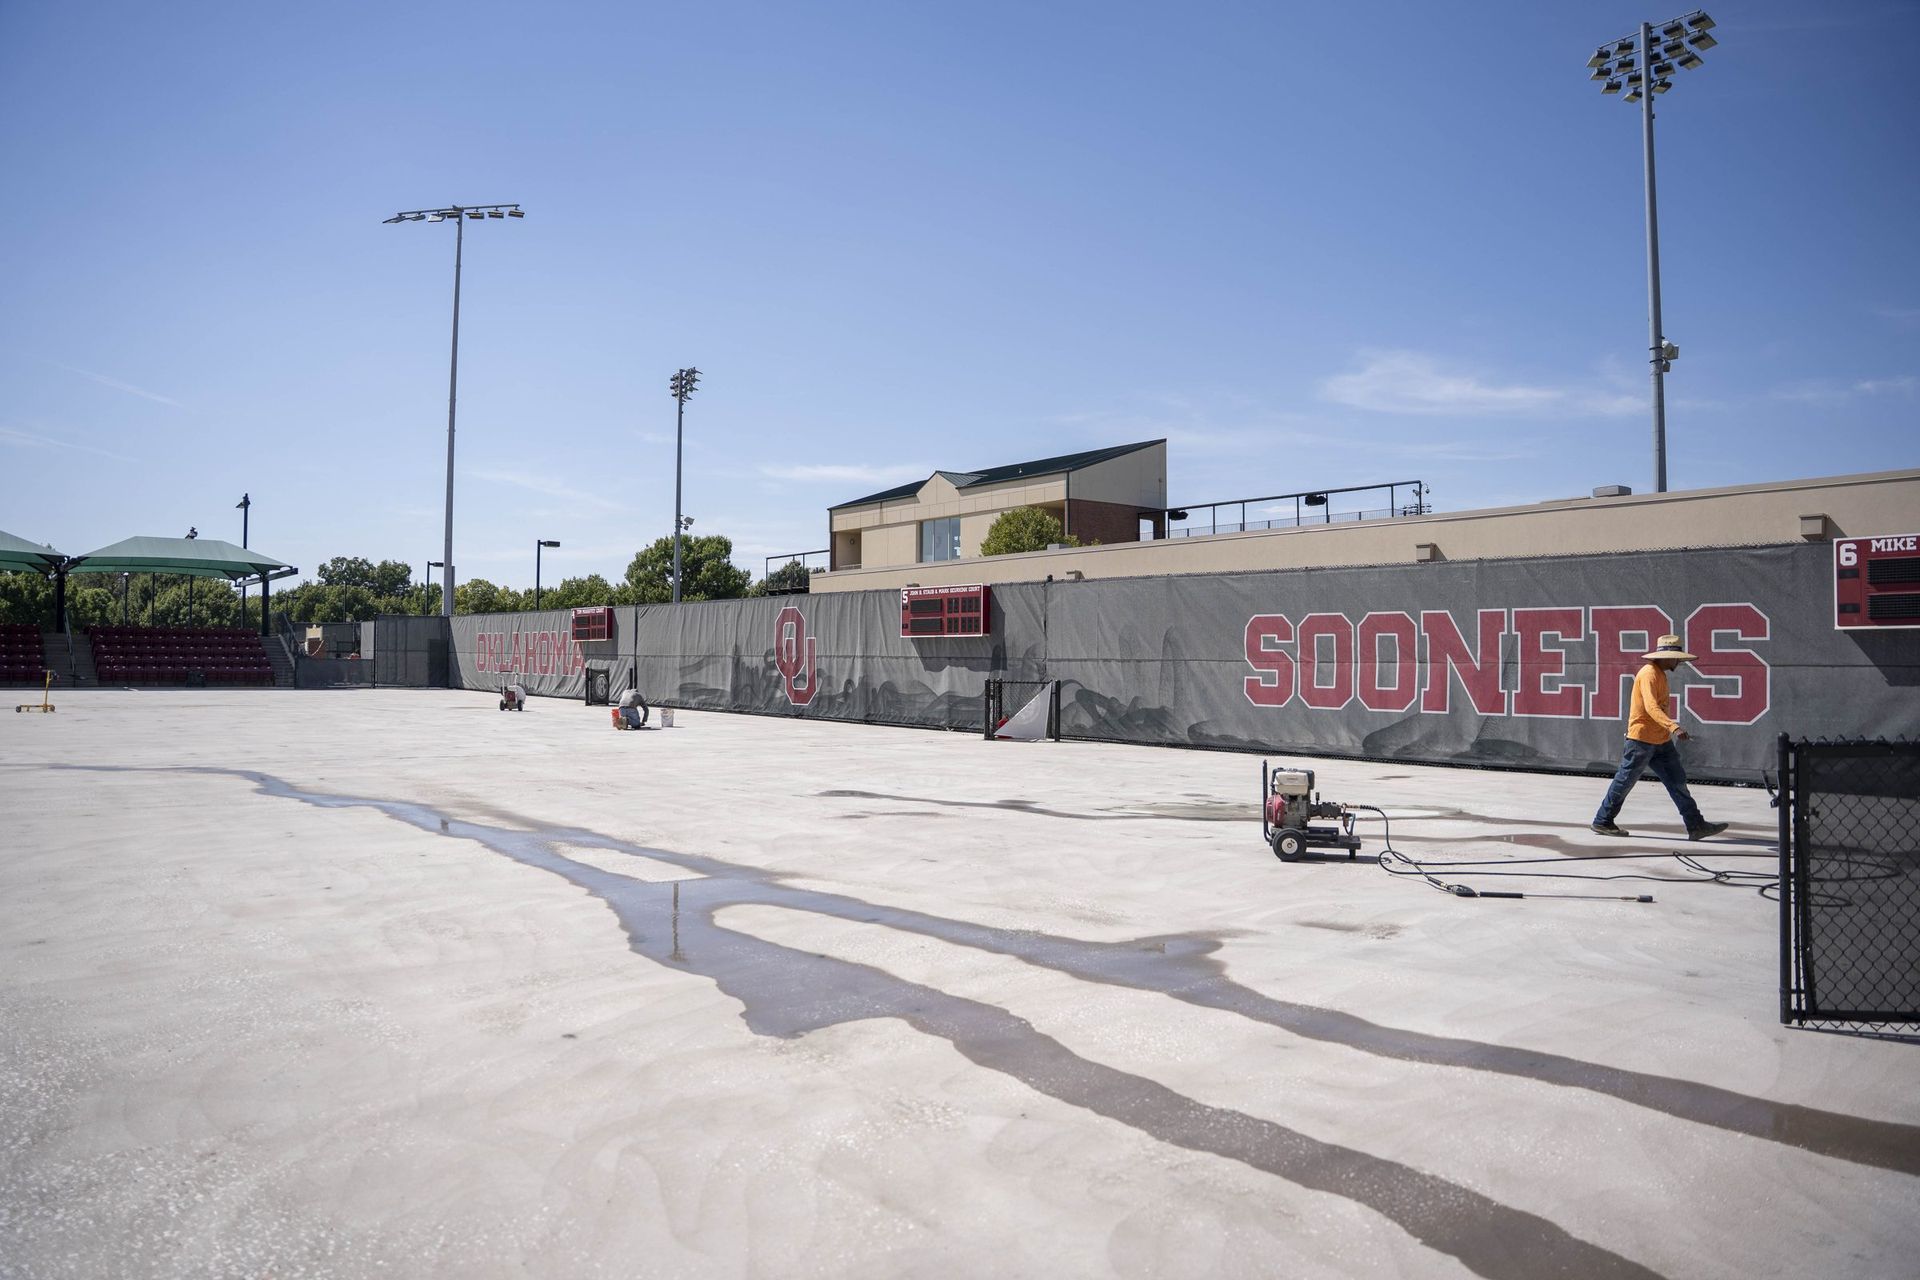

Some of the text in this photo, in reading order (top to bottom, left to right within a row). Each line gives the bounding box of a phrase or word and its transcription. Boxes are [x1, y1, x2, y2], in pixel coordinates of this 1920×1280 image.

[1840, 543, 1857, 566] 6
[1871, 537, 1917, 552] MIKE
[902, 591, 908, 603] 5
[476, 631, 586, 677] OKLAHOMA
[774, 606, 817, 705] OU
[1244, 602, 1770, 725] SOONERS
